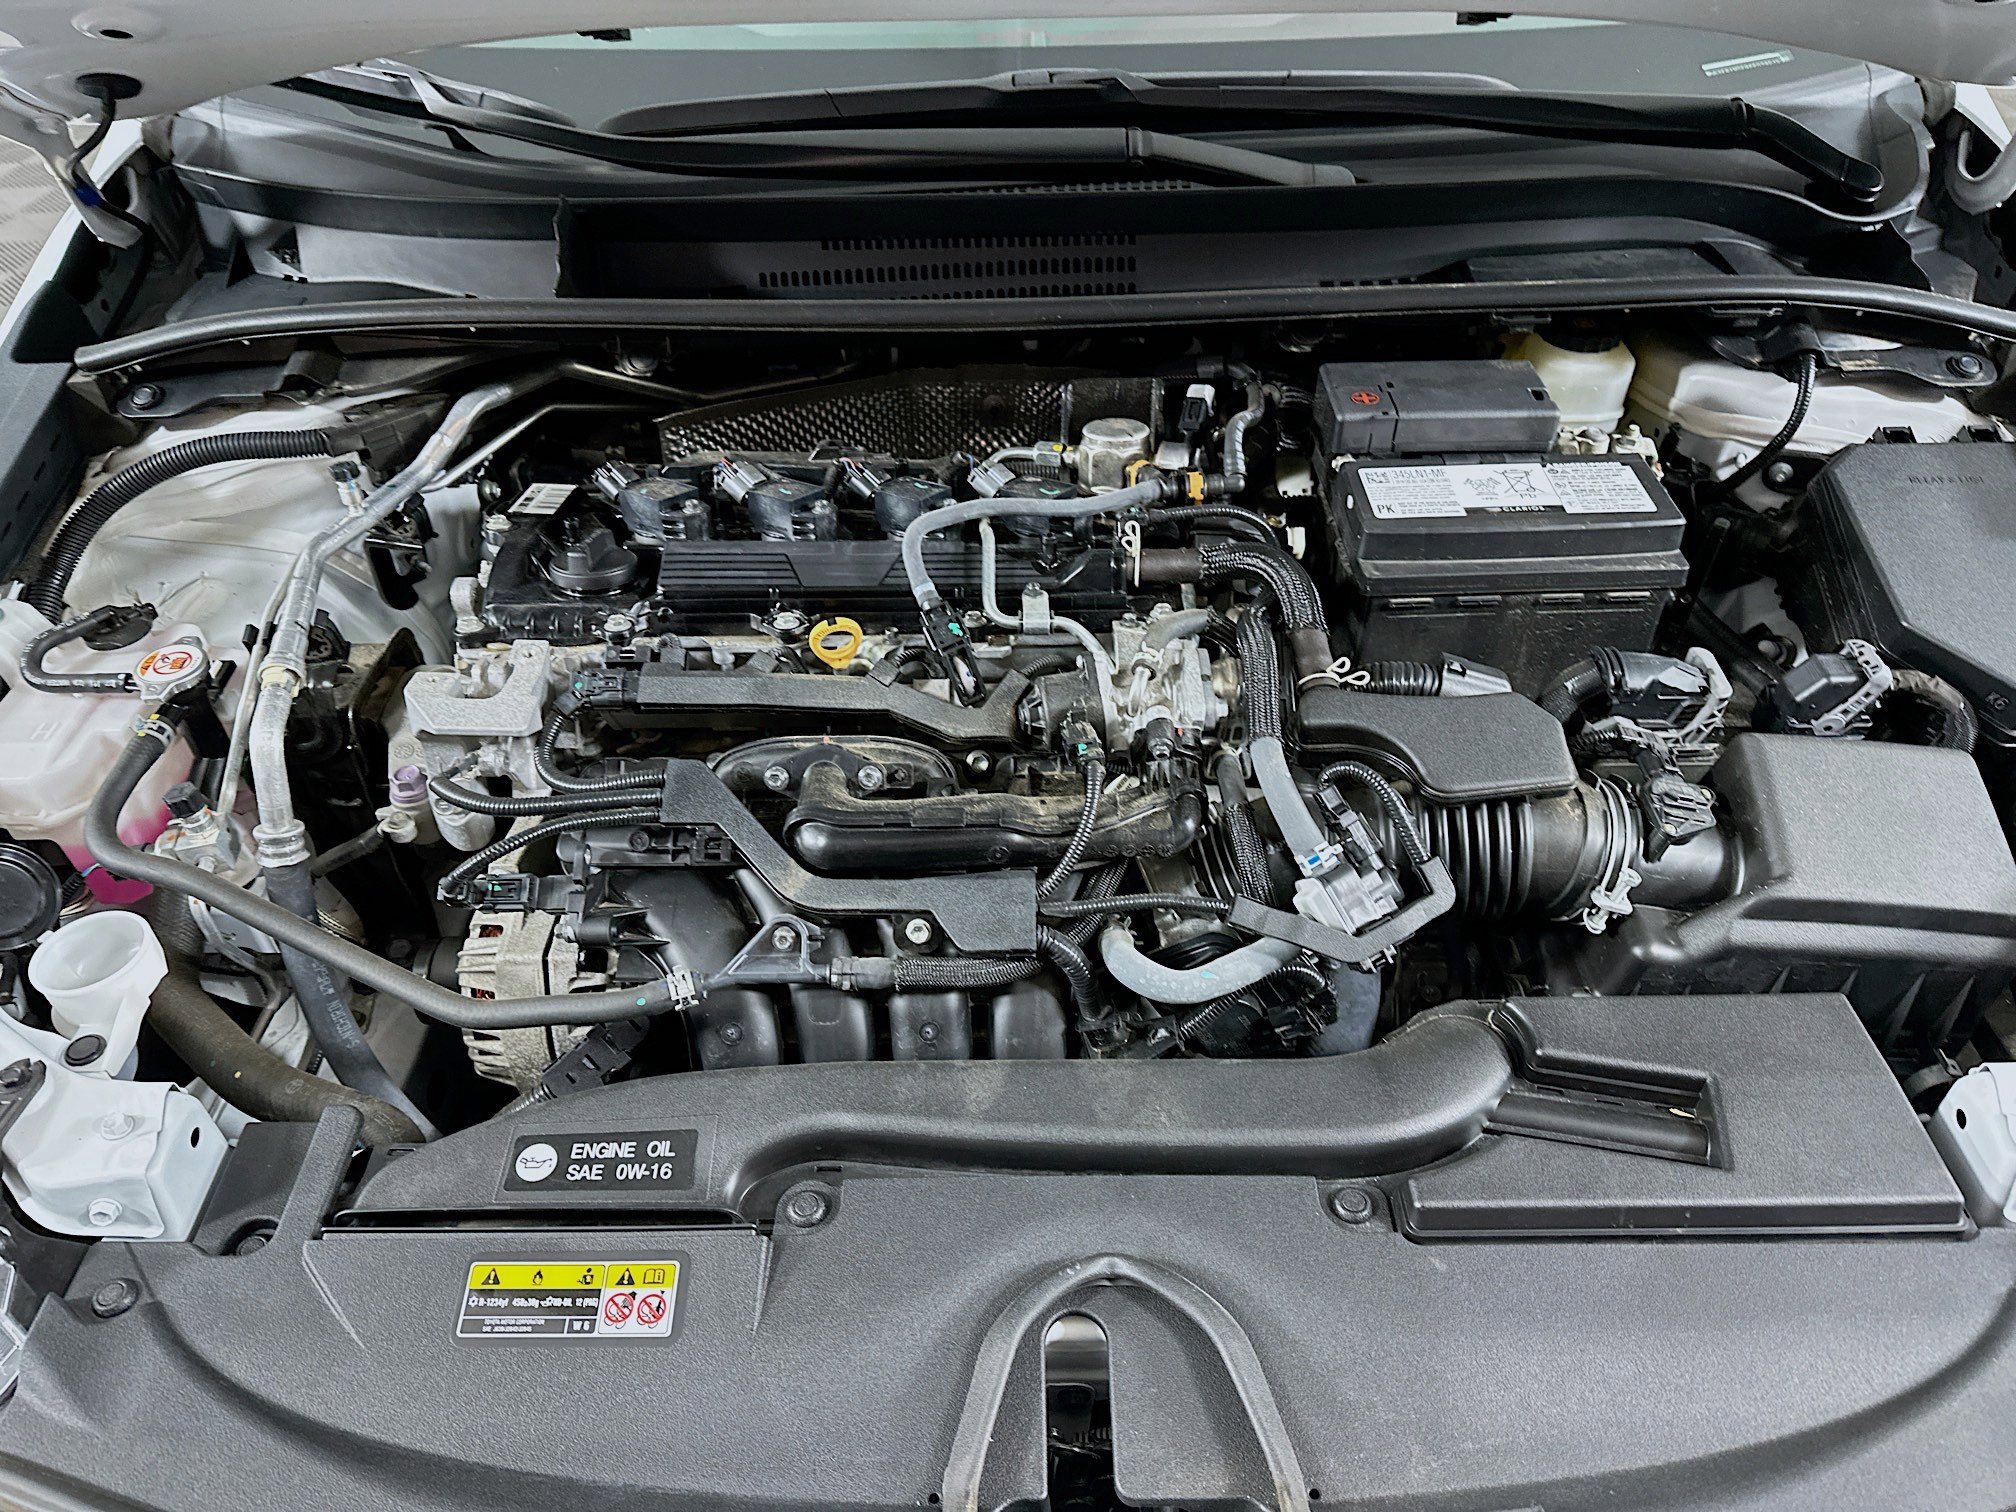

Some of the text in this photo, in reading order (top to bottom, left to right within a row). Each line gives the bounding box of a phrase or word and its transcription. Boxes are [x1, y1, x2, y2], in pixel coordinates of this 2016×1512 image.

[1376, 503, 1396, 514] PK
[570, 1140, 676, 1160] ENGINE OIL
[565, 1162, 673, 1181] SAE 0W-16
